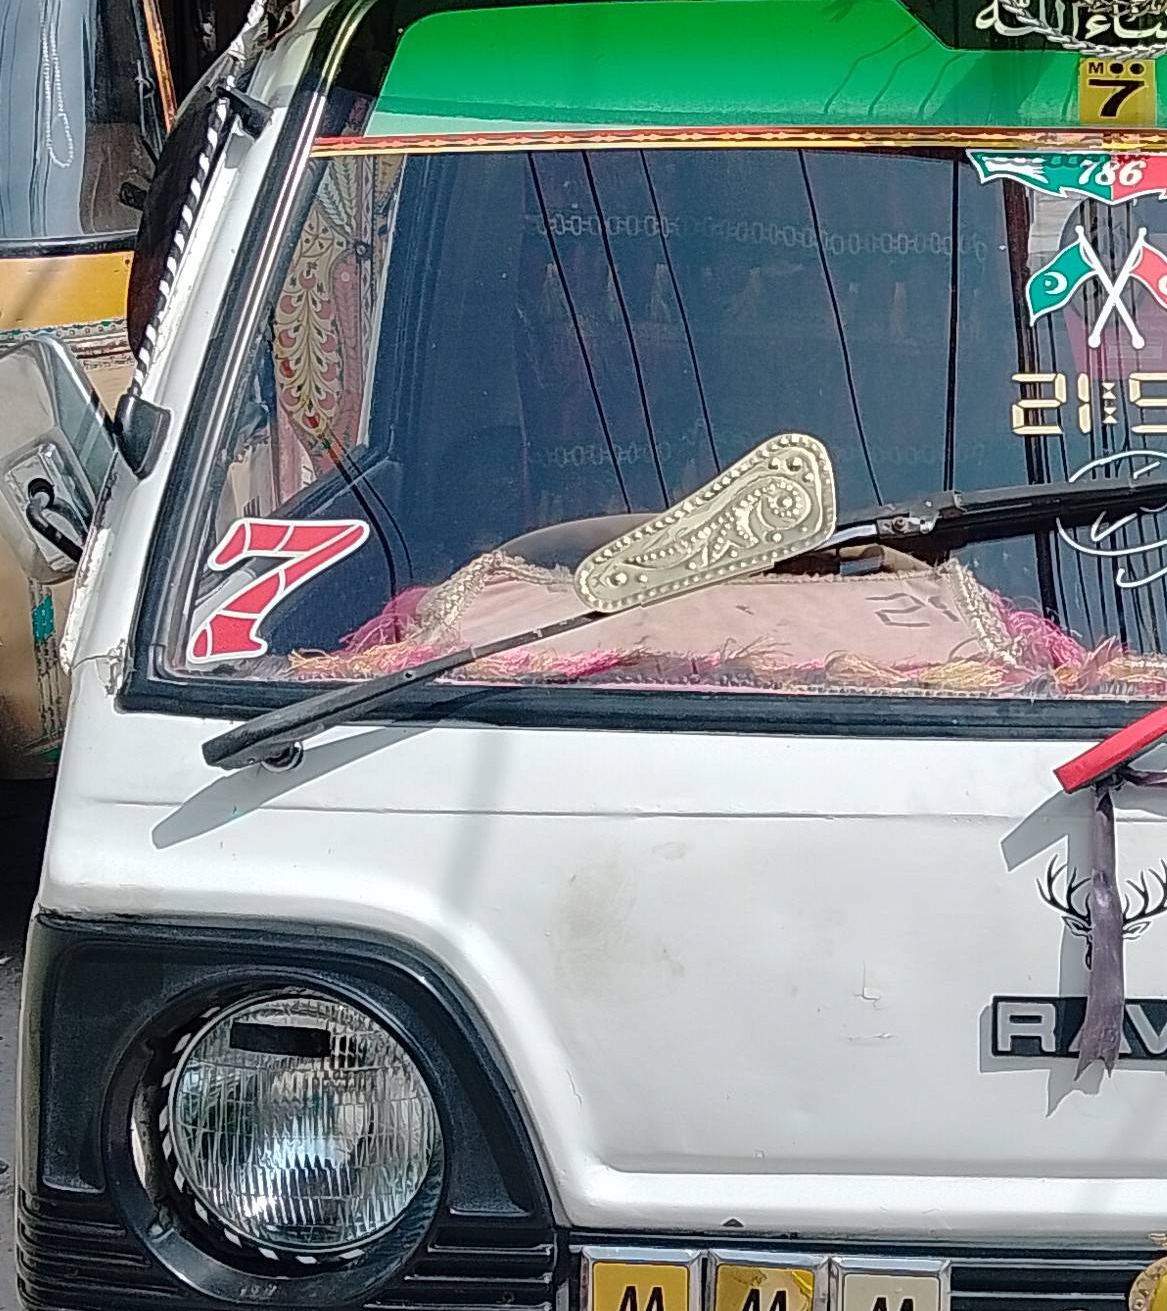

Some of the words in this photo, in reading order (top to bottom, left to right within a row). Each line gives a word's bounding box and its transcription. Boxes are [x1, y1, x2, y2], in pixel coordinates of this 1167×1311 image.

[1088, 79, 1145, 117] 7
[1077, 159, 1147, 187] 786
[186, 517, 370, 664] 7
